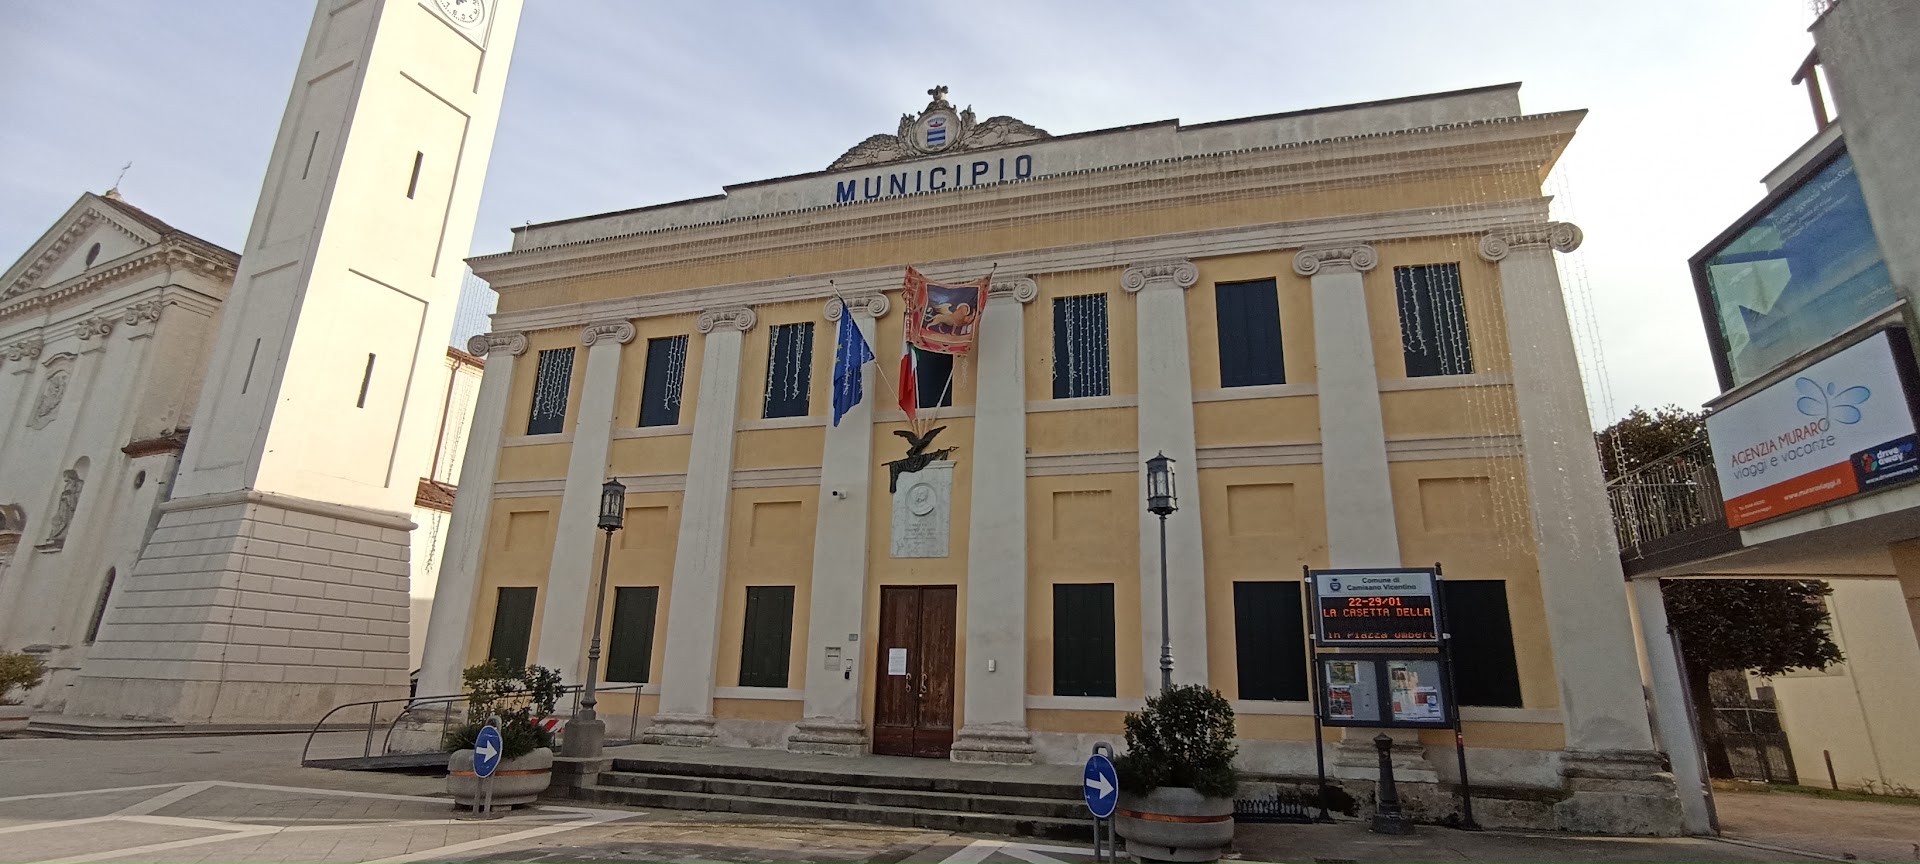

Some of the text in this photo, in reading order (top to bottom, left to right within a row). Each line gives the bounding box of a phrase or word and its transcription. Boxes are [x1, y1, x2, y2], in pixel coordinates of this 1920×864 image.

[836, 154, 1033, 203] MUNICIPIO
[1731, 417, 1830, 468] AGENZIA MURARO
[1733, 434, 1836, 480] viaggi e vacanze
[1876, 446, 1899, 459] drive
[1878, 452, 1904, 466] away
[1348, 597, 1402, 607] 22-29/01
[1323, 607, 1431, 617] LA CASETTA DELLA
